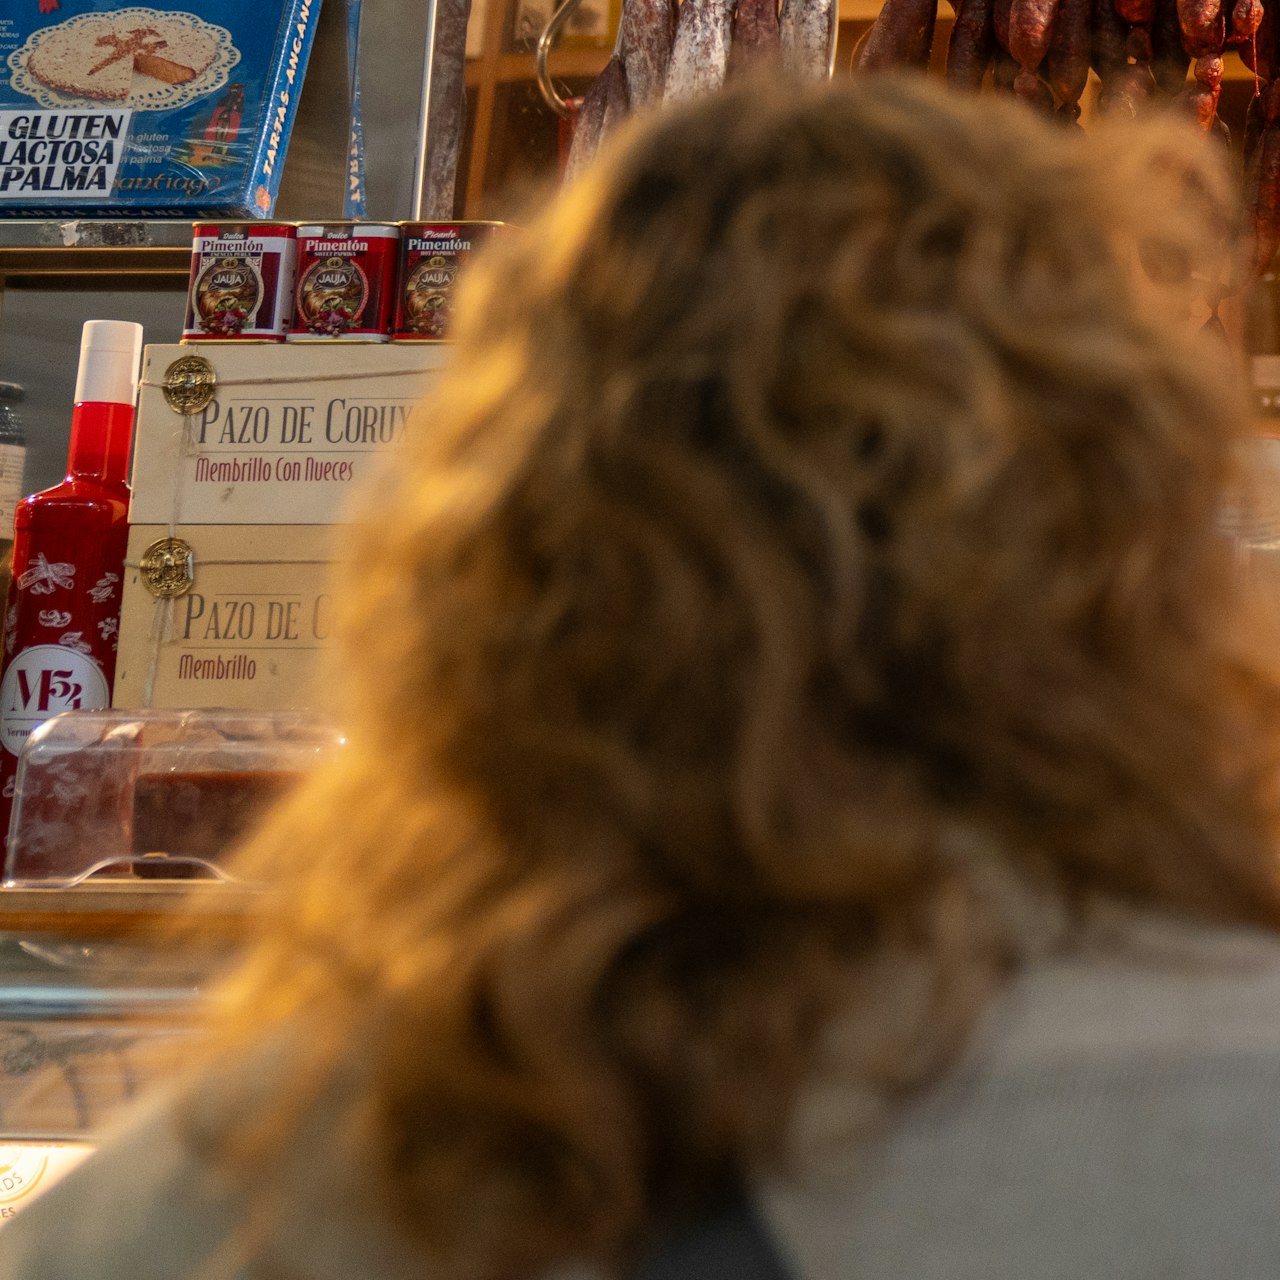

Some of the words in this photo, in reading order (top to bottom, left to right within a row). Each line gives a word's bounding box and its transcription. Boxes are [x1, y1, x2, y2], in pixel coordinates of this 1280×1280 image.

[8, 115, 124, 140] GLUTEN
[263, 92, 290, 177] TARTAS
[0, 140, 114, 165] LACTOSA
[1, 166, 107, 191] PALMA
[223, 232, 245, 240] Dulce
[327, 232, 349, 240] Dulce
[424, 229, 457, 239] Picante
[201, 239, 264, 252] Pimentón
[305, 238, 369, 252] Pimentón
[408, 238, 472, 251] Pimentón
[214, 273, 242, 285] JAUJA
[317, 272, 347, 284] JAUJA
[421, 272, 452, 283] JAUJA
[199, 397, 270, 445] PAZO
[281, 405, 316, 444] DE
[195, 456, 272, 482] Membrillo
[275, 457, 302, 482] Con
[304, 457, 354, 482] Nueces
[181, 593, 256, 640] PAZO
[266, 602, 301, 640] DE
[178, 654, 257, 680] Membrillo
